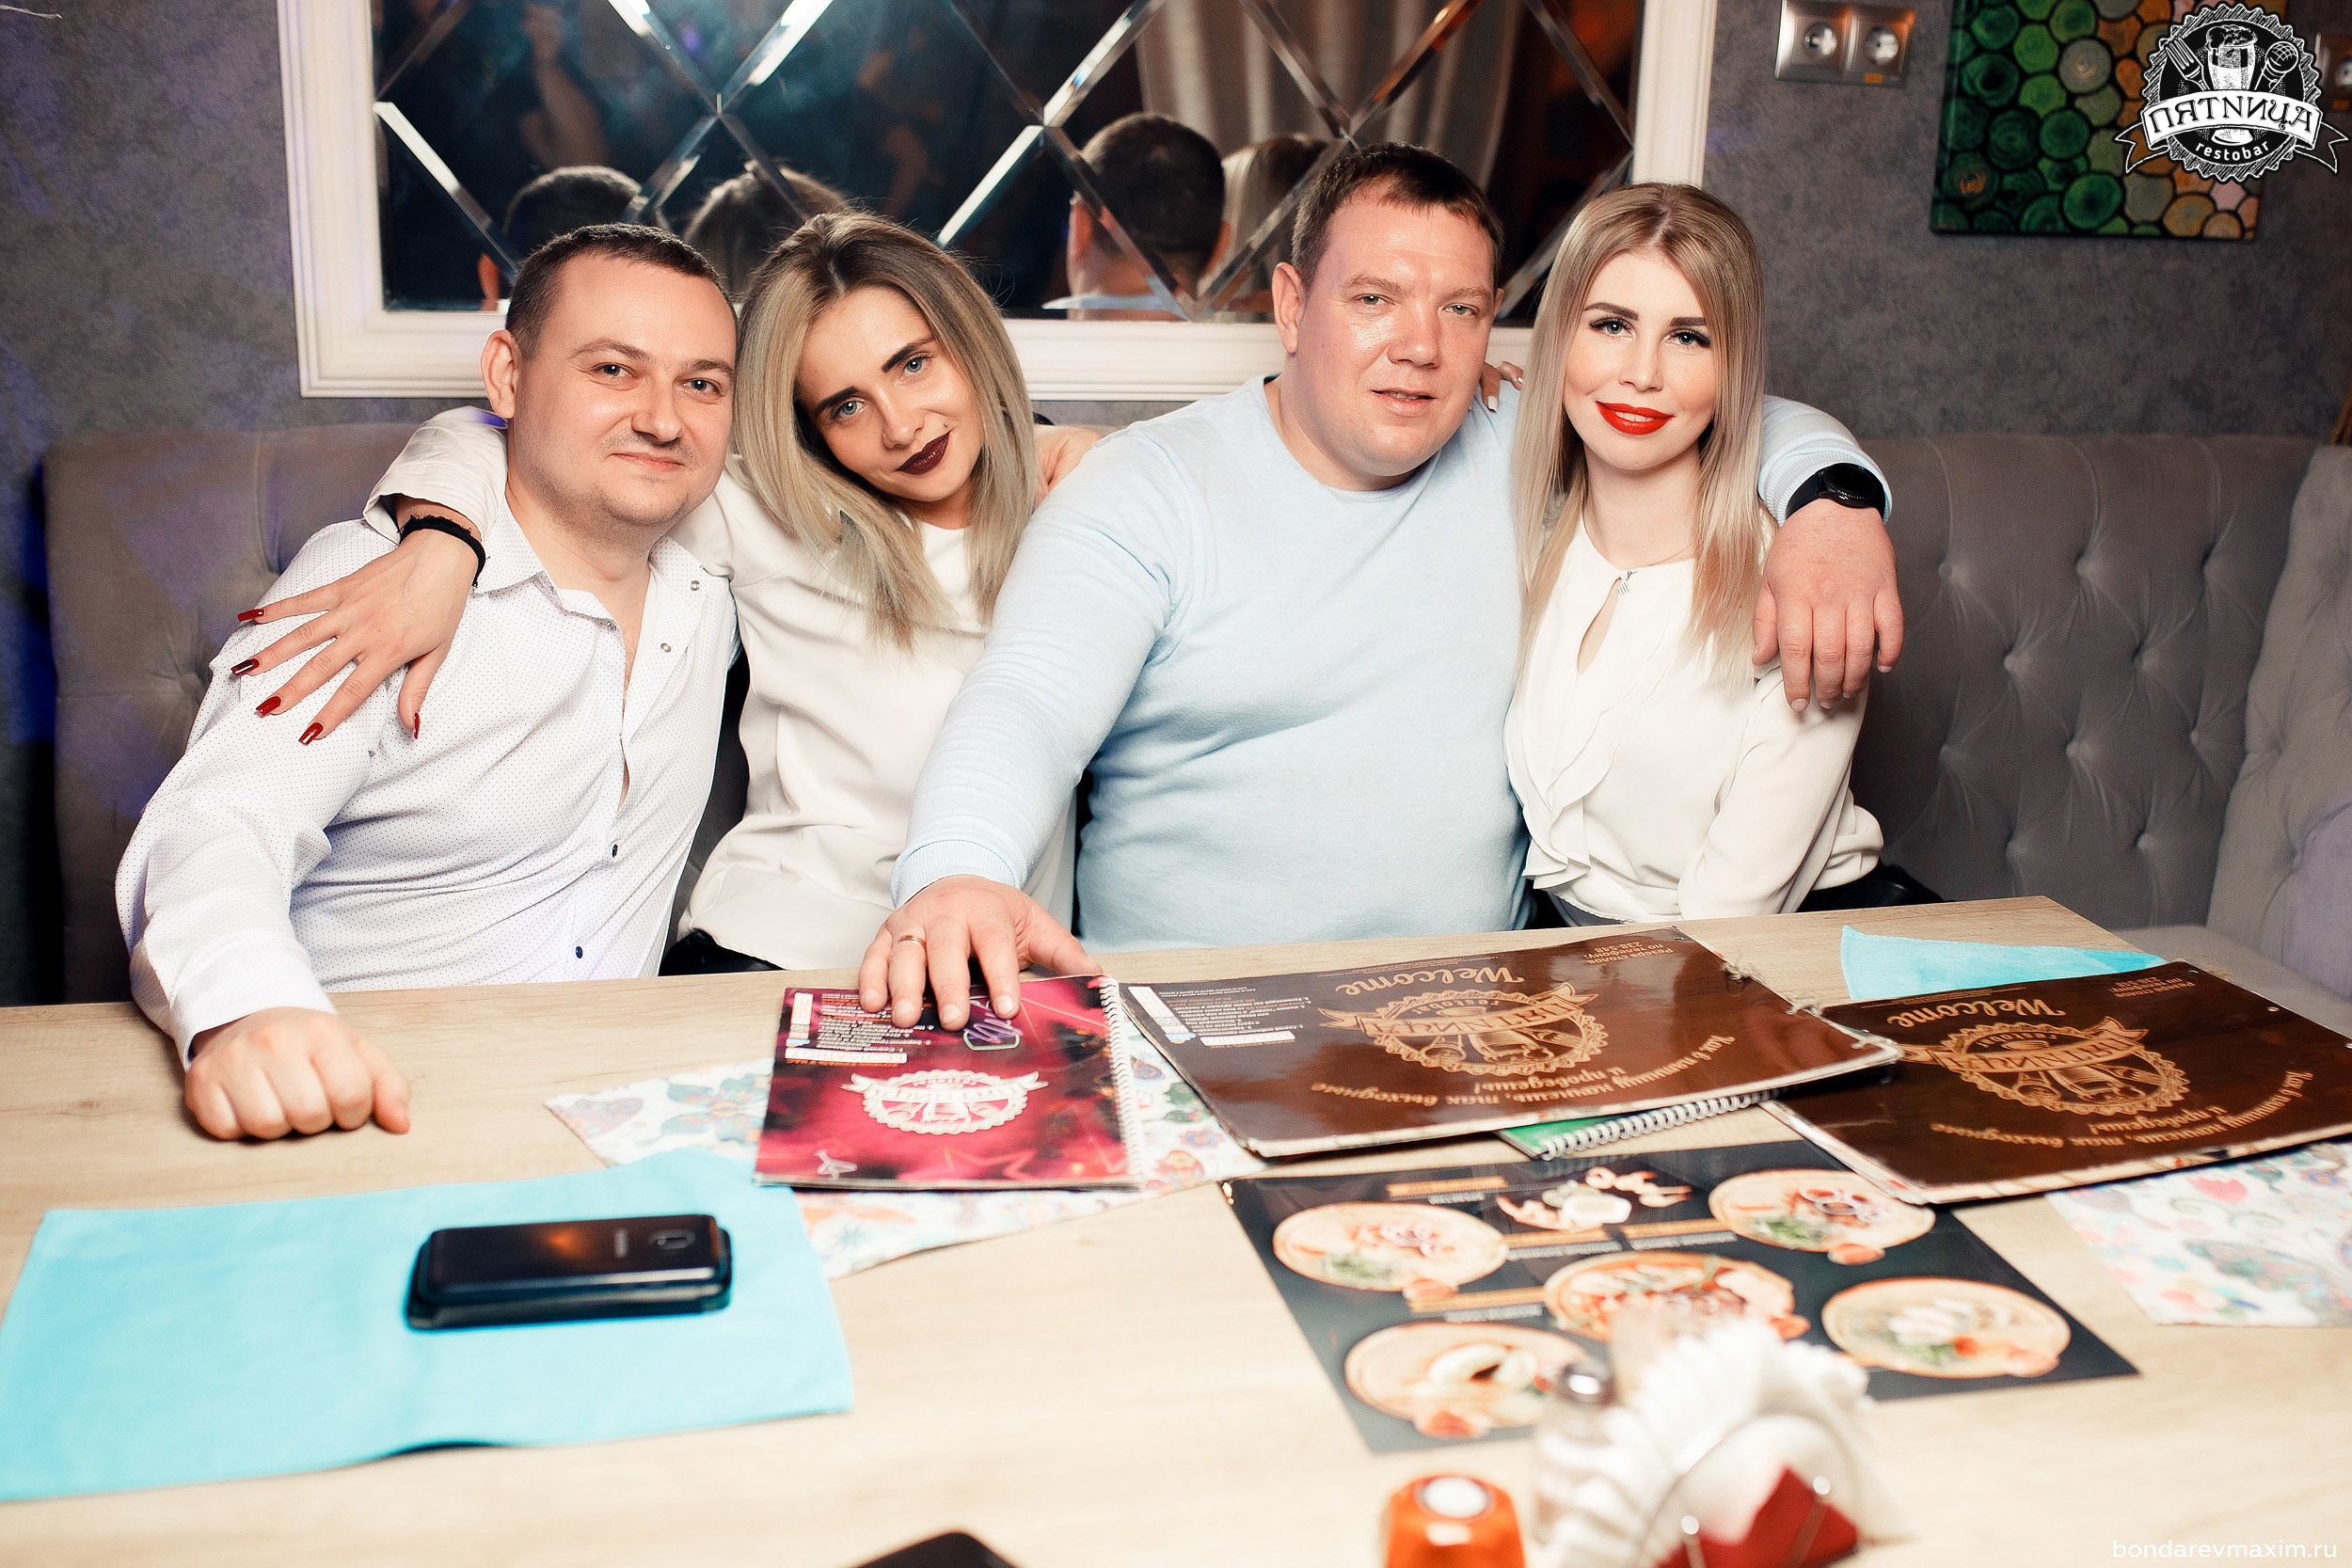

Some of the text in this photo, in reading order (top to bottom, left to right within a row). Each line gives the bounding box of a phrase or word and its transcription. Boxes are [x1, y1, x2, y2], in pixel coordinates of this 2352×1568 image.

[1336, 967, 1524, 995] Welcome
[1411, 999, 1499, 1015] restobar
[1886, 999, 2067, 1028] Welcome
[1699, 1035, 1736, 1053] Как
[1310, 1082, 1439, 1106] выходные
[1444, 1094, 1500, 1105] так
[2068, 1136, 2124, 1148] так
